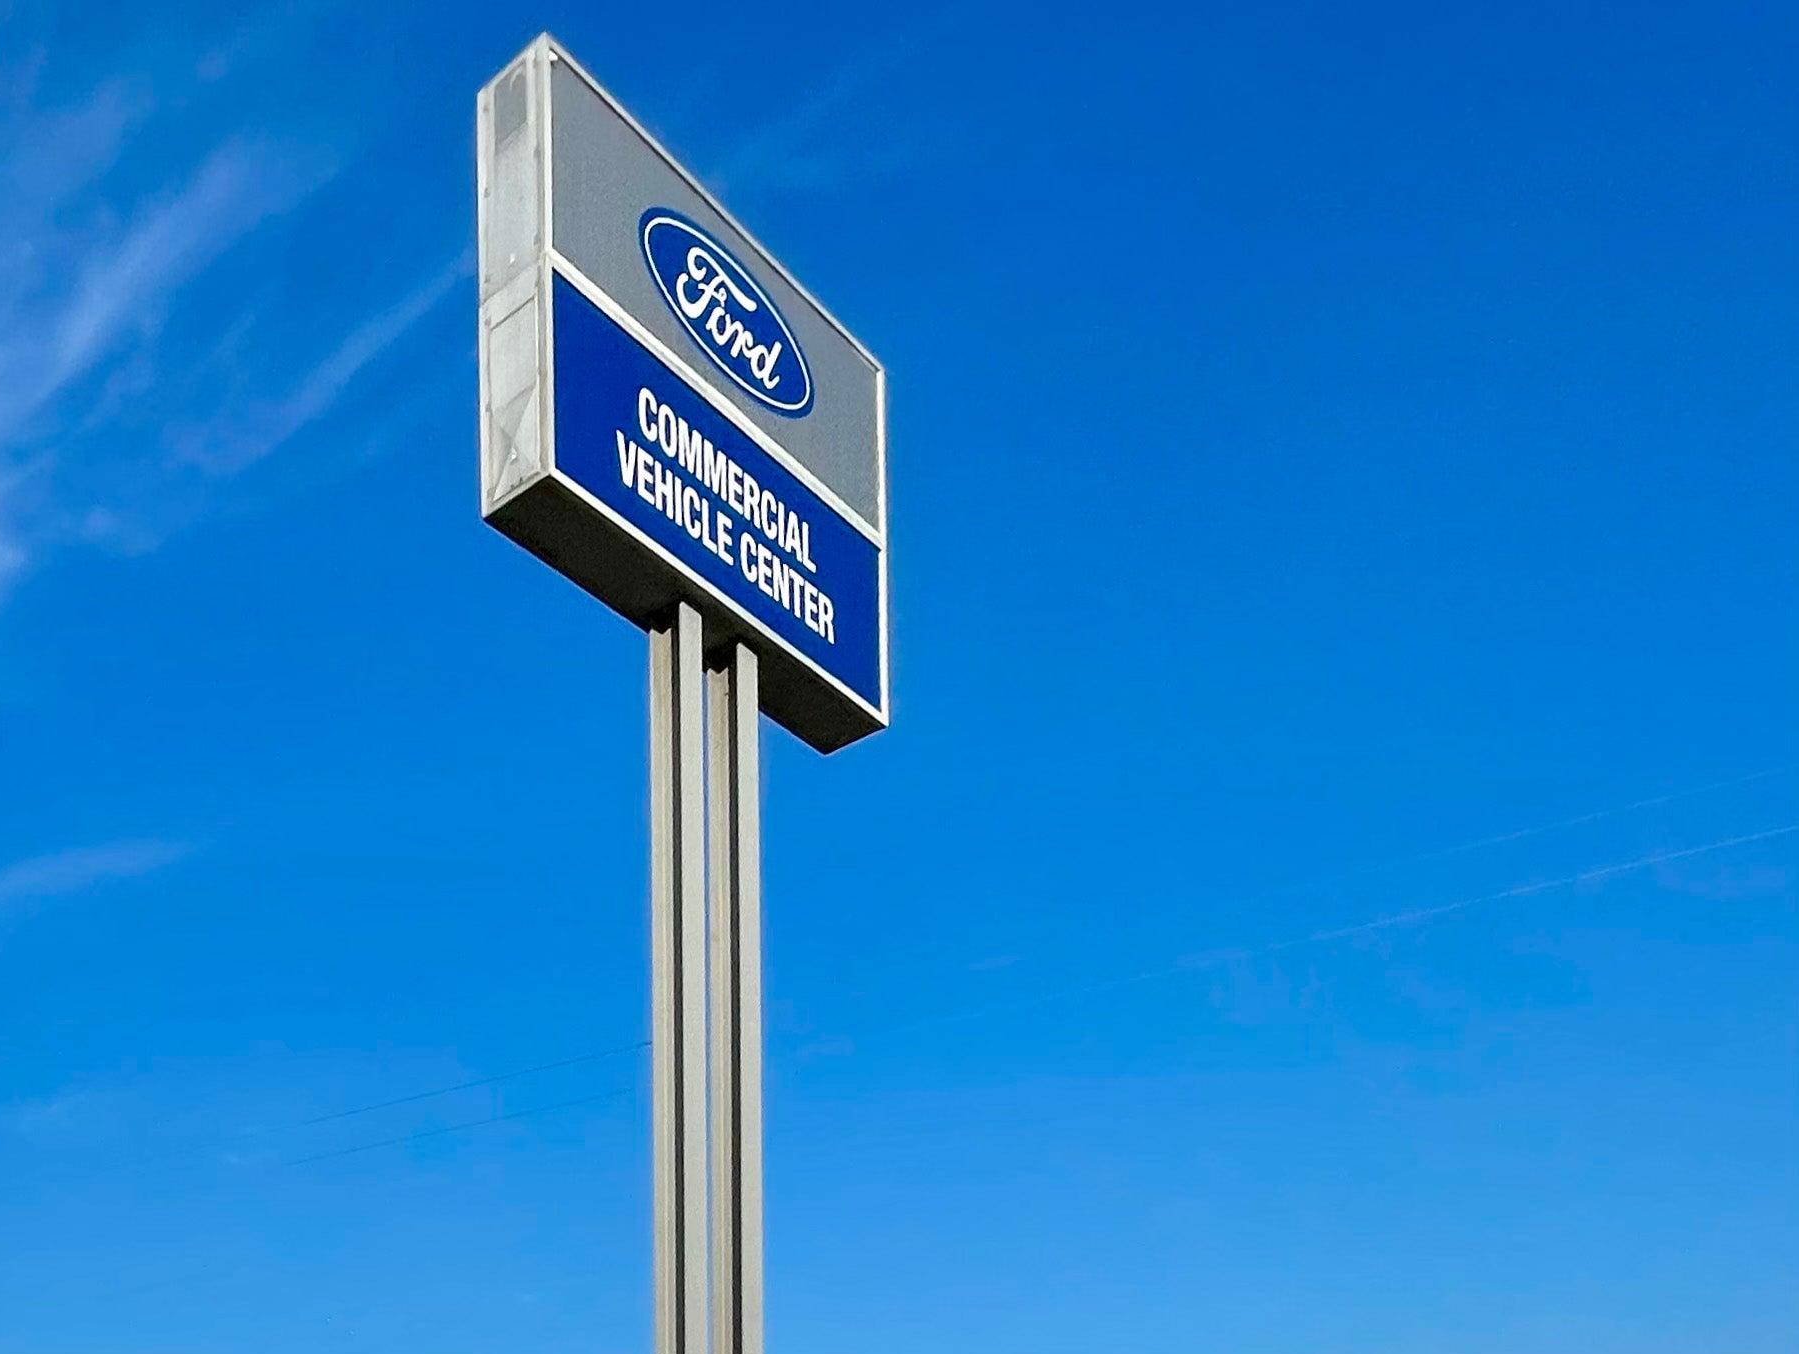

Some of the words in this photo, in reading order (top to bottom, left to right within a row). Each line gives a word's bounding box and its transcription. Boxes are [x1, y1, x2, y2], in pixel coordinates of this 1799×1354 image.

[676, 246, 782, 390] Ford
[616, 430, 734, 566] VEHICLE
[739, 531, 835, 645] CENTER
[638, 387, 817, 573] COMMERCIAL
